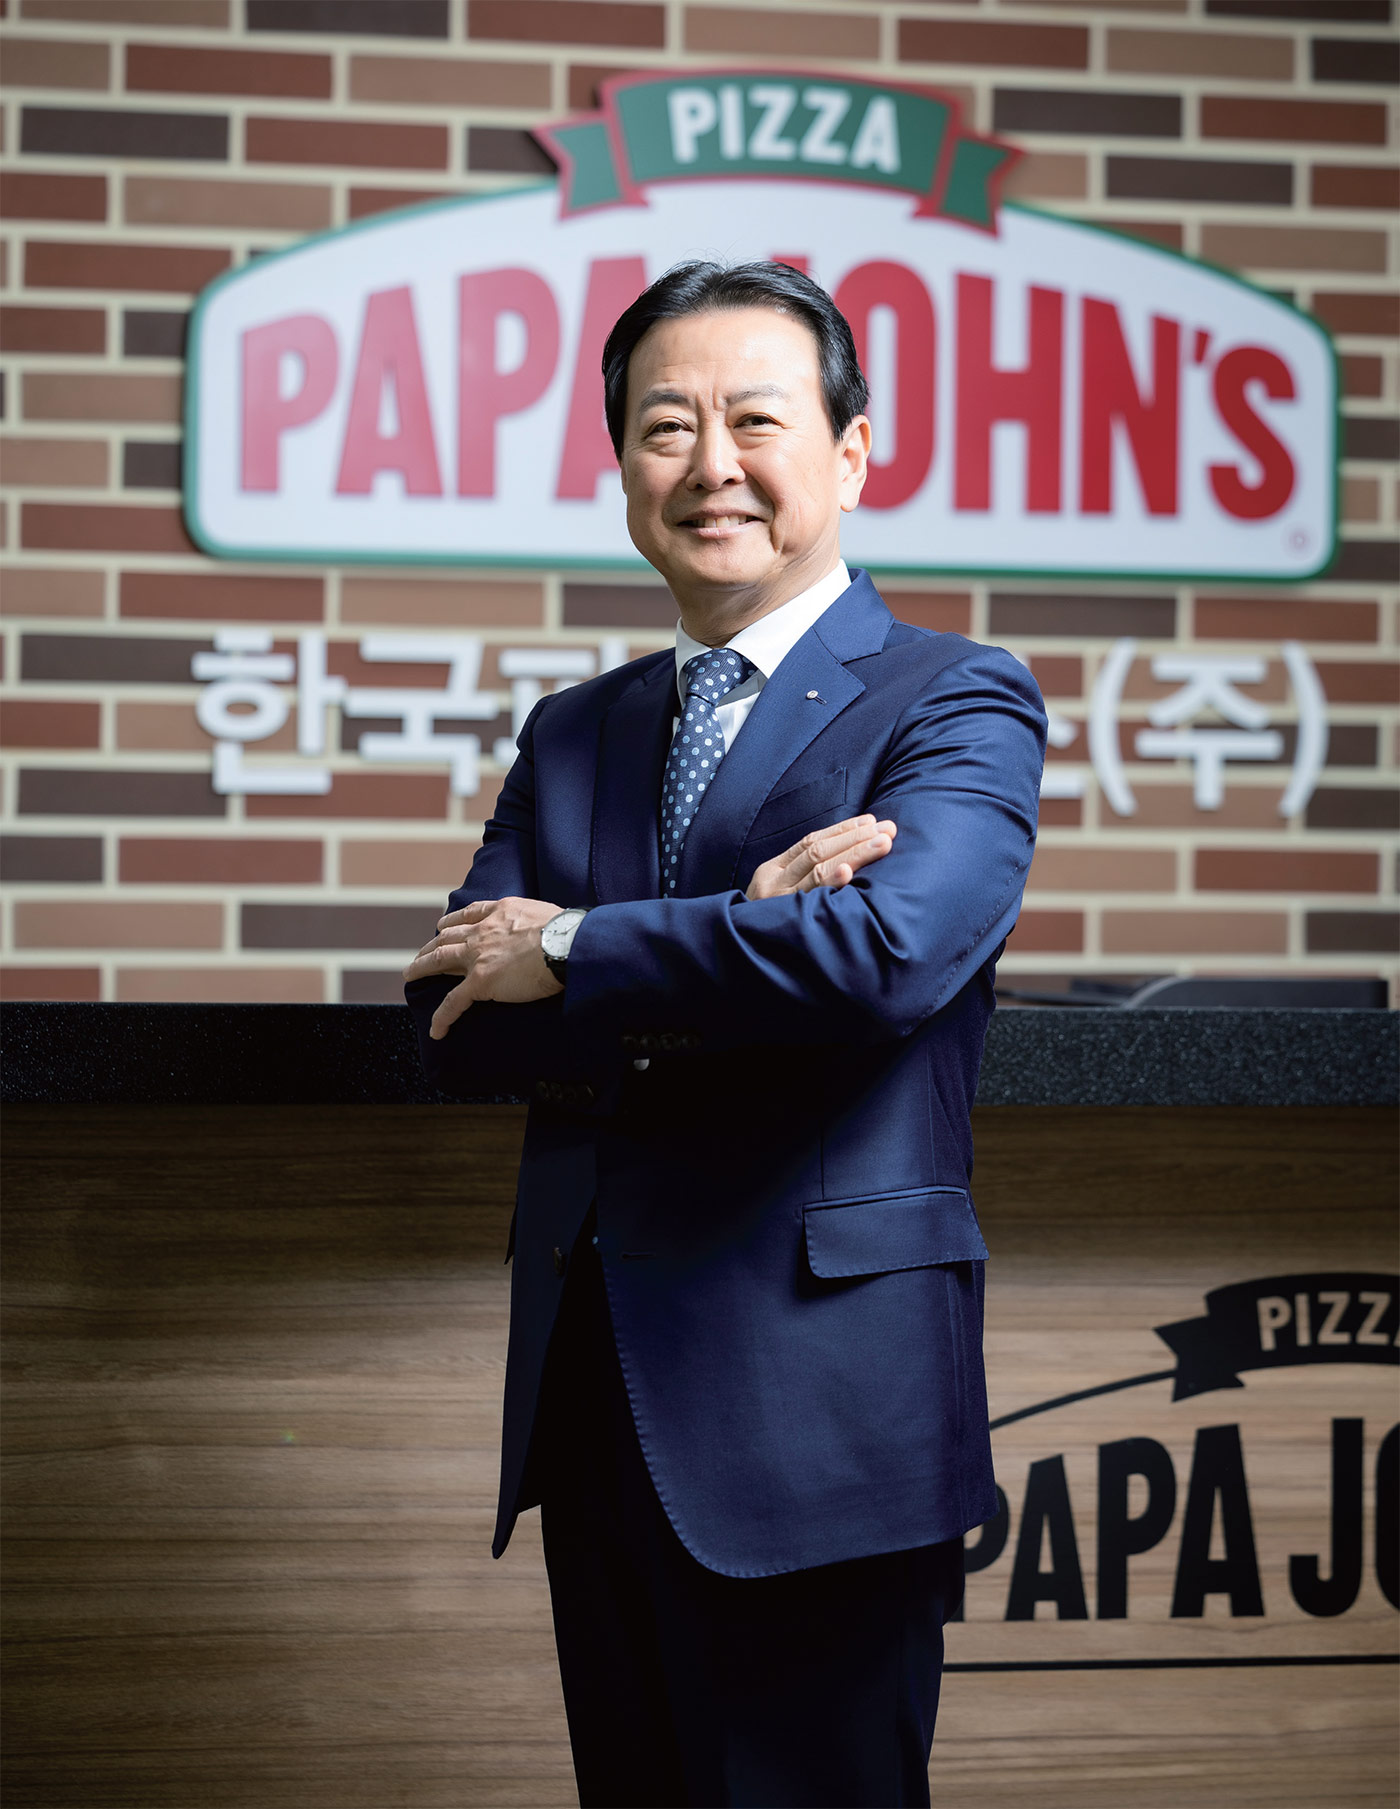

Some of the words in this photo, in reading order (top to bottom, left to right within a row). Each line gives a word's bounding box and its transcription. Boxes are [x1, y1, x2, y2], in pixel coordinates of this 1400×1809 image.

[668, 84, 900, 174] PIZZA
[769, 254, 1297, 524] OHN'S
[1256, 1290, 1400, 1352] PIZZ
